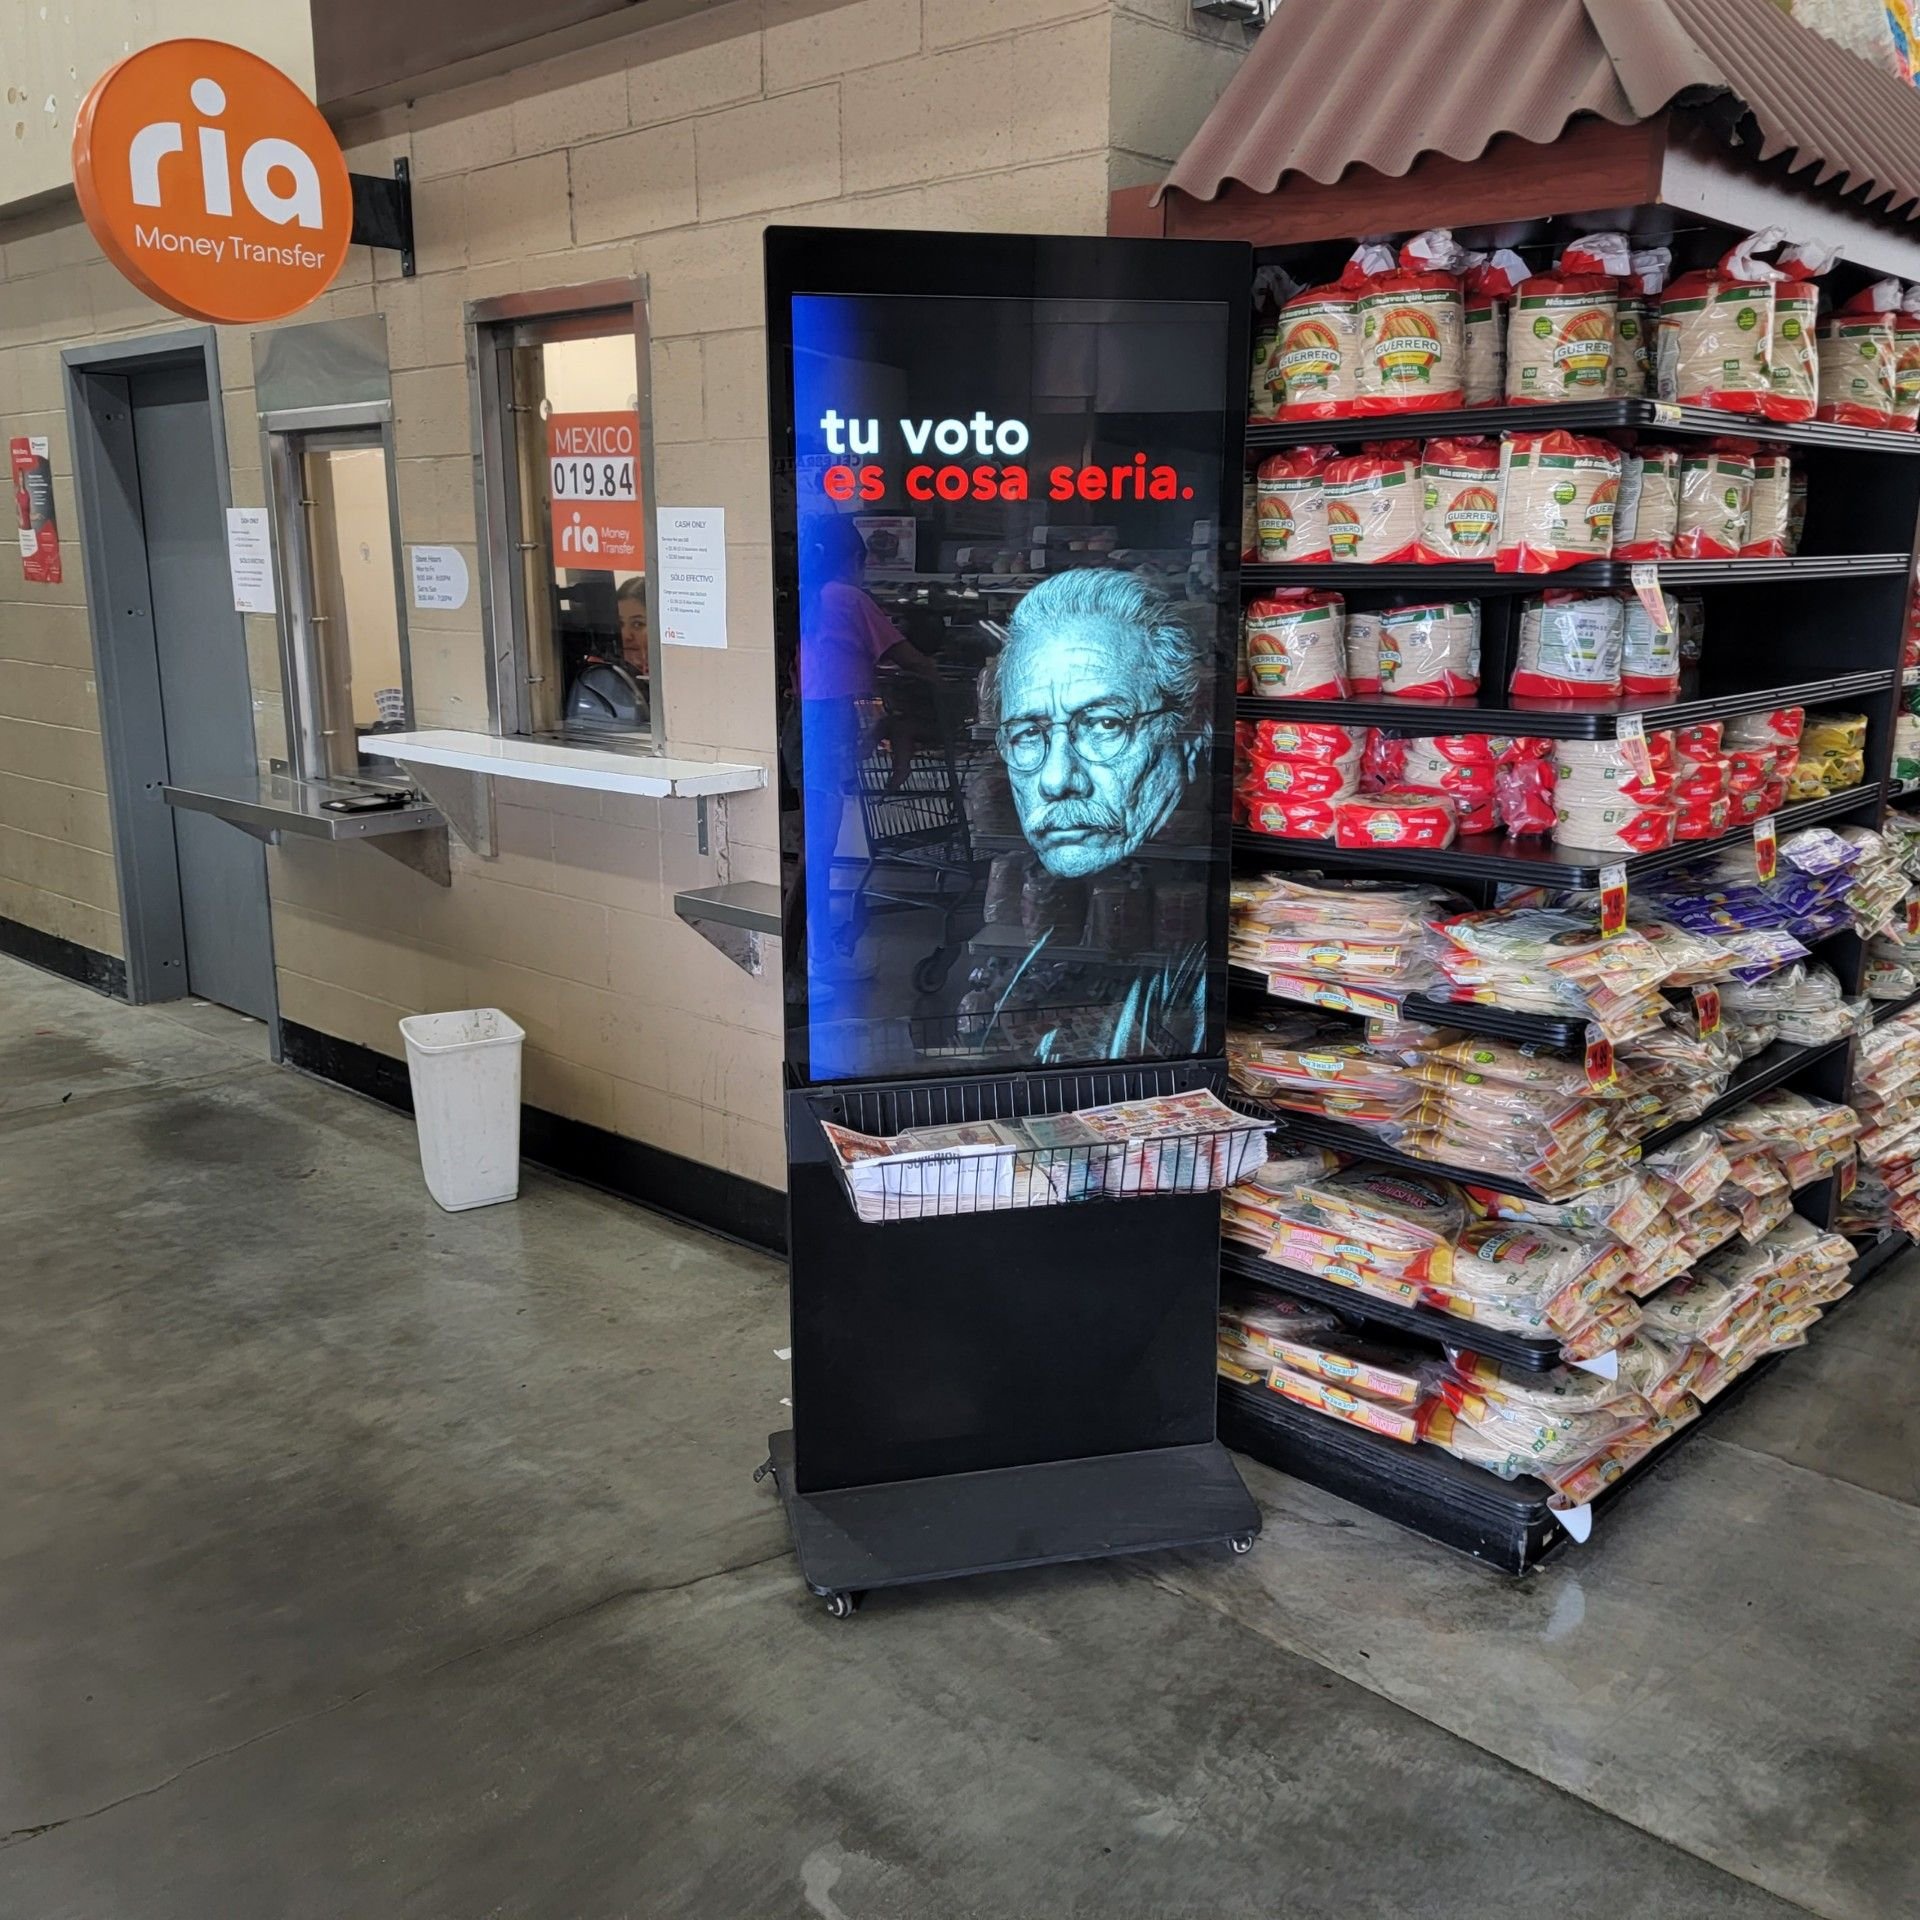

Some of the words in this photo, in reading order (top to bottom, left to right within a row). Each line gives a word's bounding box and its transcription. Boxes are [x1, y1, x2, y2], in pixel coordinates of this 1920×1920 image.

[129, 78, 323, 229] ria
[135, 225, 224, 262] Money
[229, 236, 325, 269] Transfer
[1376, 339, 1439, 355] GUERRERO
[1280, 350, 1338, 368] GUERRERO
[555, 426, 633, 454] MEXICO
[820, 410, 879, 455] tu
[900, 411, 1029, 455] voto
[554, 462, 633, 497] 019.84
[824, 464, 885, 501] es
[906, 464, 1029, 501] cosa
[1049, 452, 1195, 501] seria.
[692, 521, 706, 529] ONLY
[1448, 512, 1498, 521] GUERRERO
[562, 512, 599, 553] ria
[601, 527, 630, 540] Money
[601, 541, 636, 555] Transfer
[686, 575, 713, 583] EFECTIVO
[1336, 1246, 1374, 1261] GUERRERO
[1325, 1267, 1363, 1284] GUERRERO
